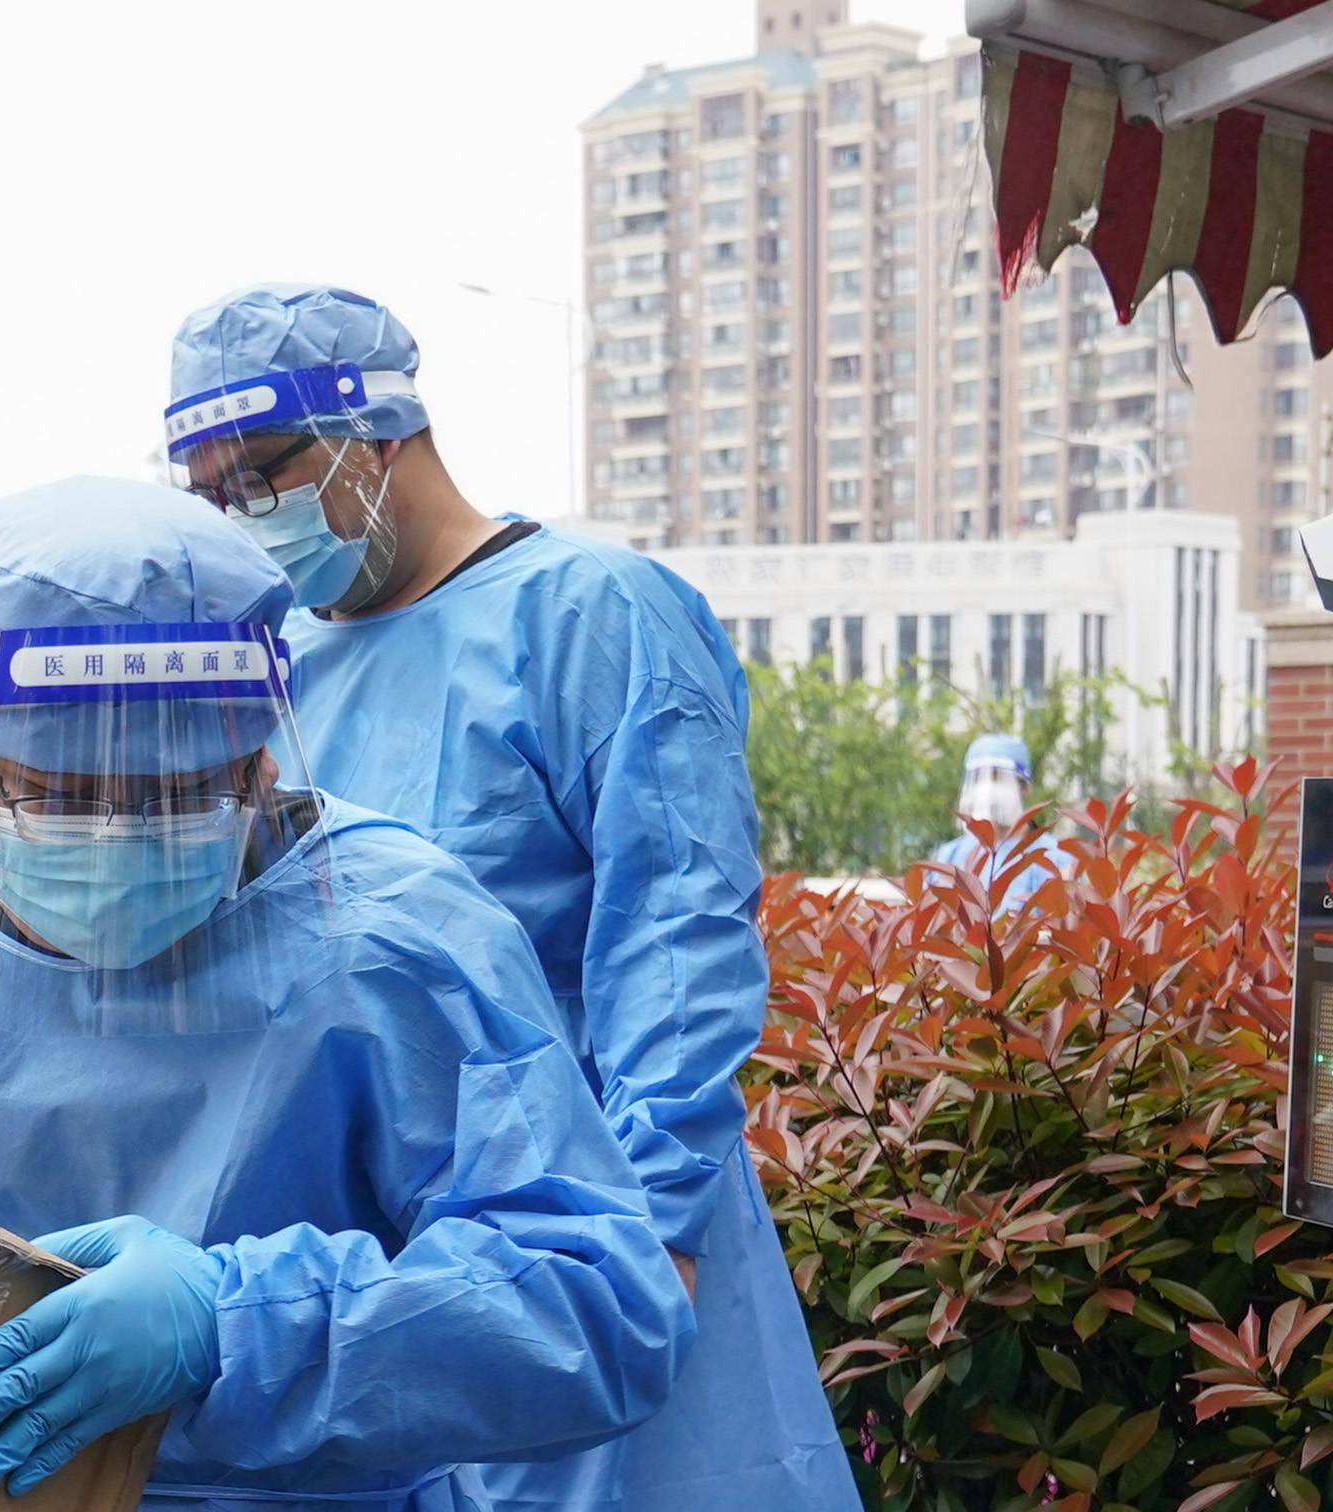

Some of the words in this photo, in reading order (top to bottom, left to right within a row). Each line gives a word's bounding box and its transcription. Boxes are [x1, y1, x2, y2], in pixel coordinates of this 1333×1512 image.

[44, 650, 250, 678] 医用隔离面罩
